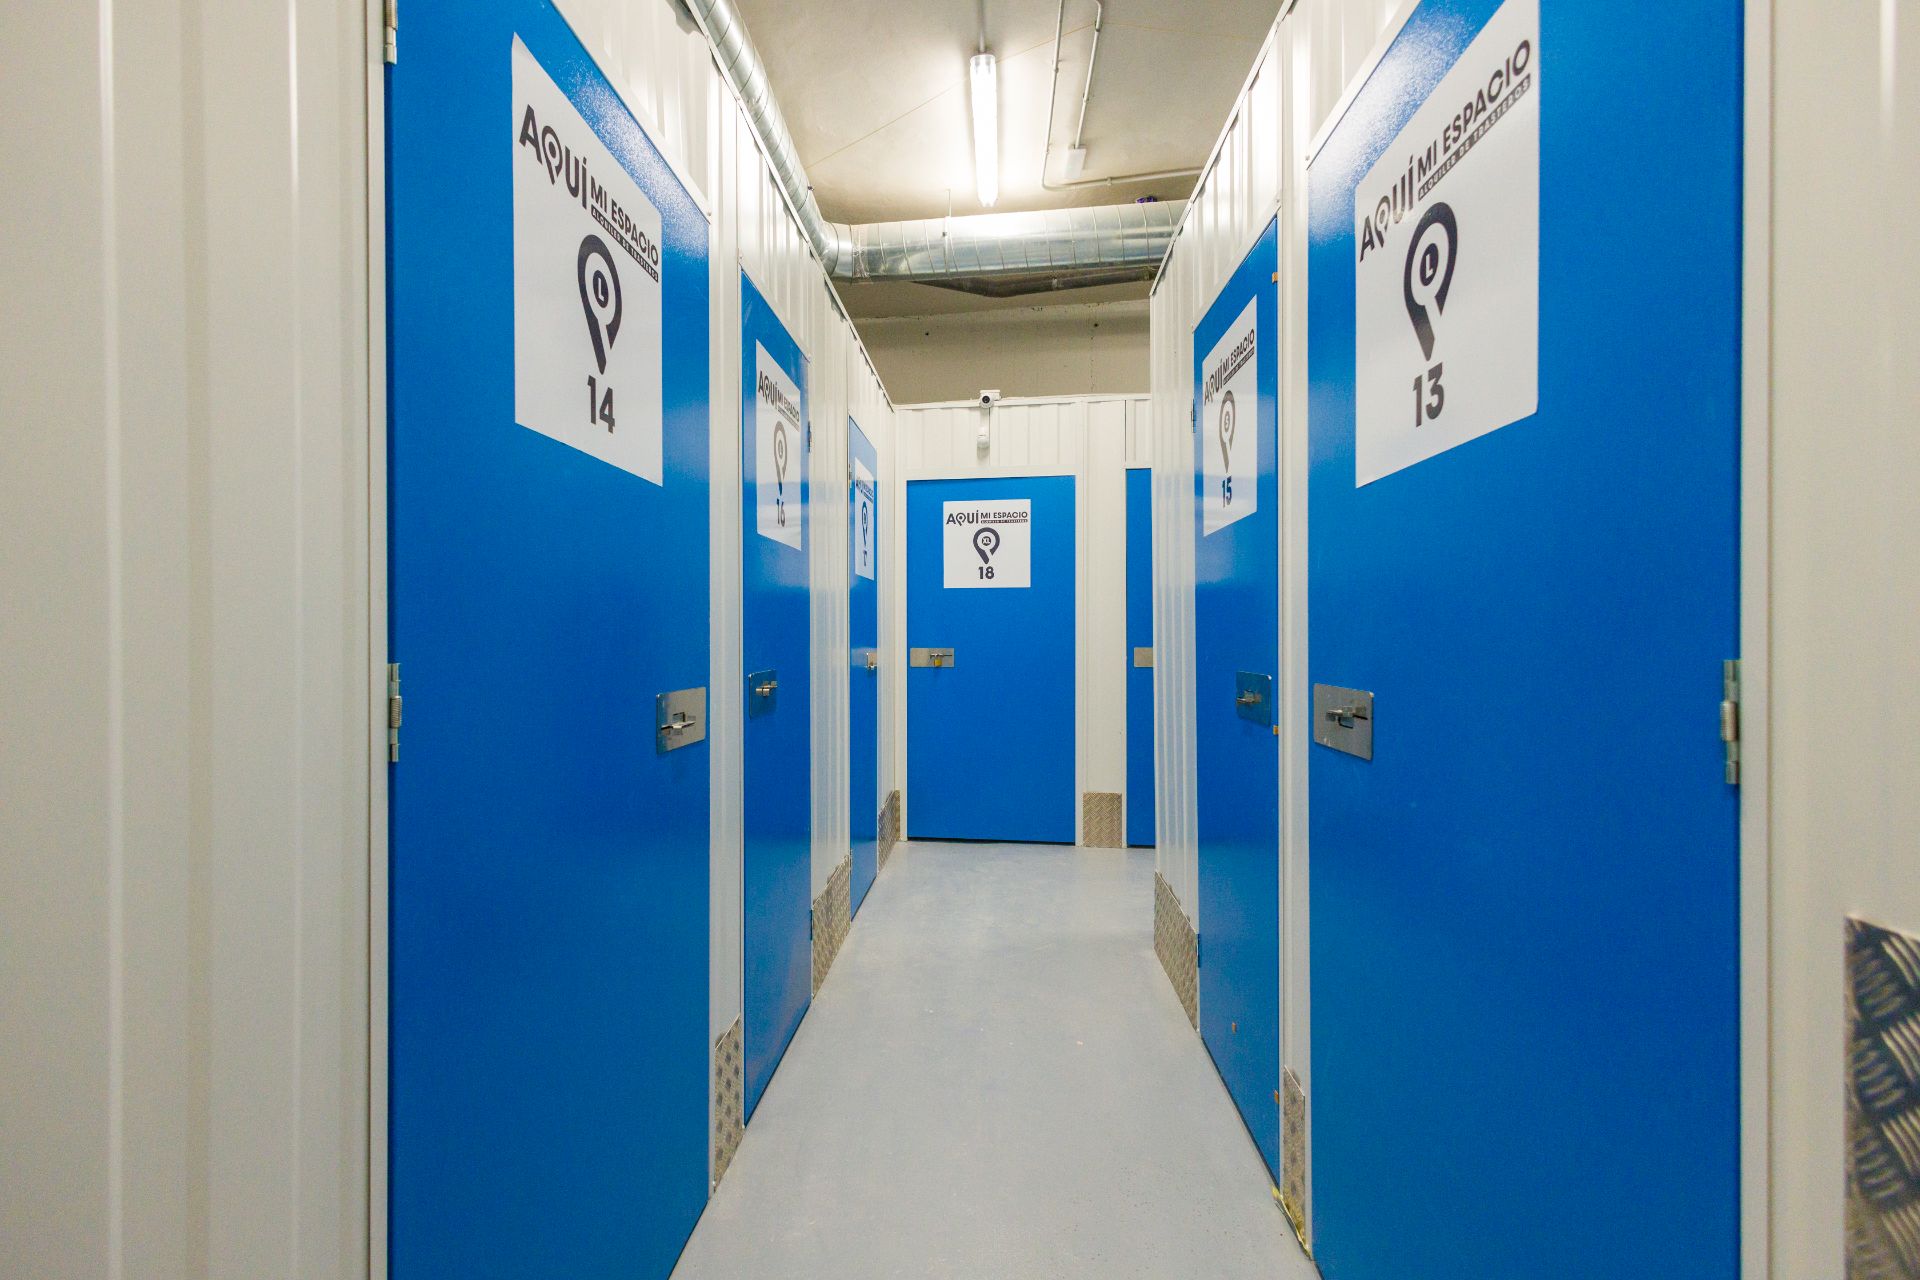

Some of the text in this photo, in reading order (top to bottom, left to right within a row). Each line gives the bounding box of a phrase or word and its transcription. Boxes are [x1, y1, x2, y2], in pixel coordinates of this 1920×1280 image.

[1360, 40, 1530, 263] AQUÍ MI ESPACIO
[1418, 78, 1530, 198] ALQUILER DE TRASTEROS
[519, 104, 658, 266] AQUÍ MI ESPACIO
[1425, 253, 1433, 278] L
[597, 277, 604, 301] L
[1223, 357, 1229, 375] MI
[1231, 328, 1254, 367] ESPACIO
[587, 375, 615, 434] 14
[1413, 362, 1444, 427] 13
[1222, 475, 1232, 508] 15
[777, 498, 785, 527] 16
[946, 510, 978, 526] AQUÍ
[993, 511, 1028, 519] ESPACIO
[978, 566, 994, 579] 18
